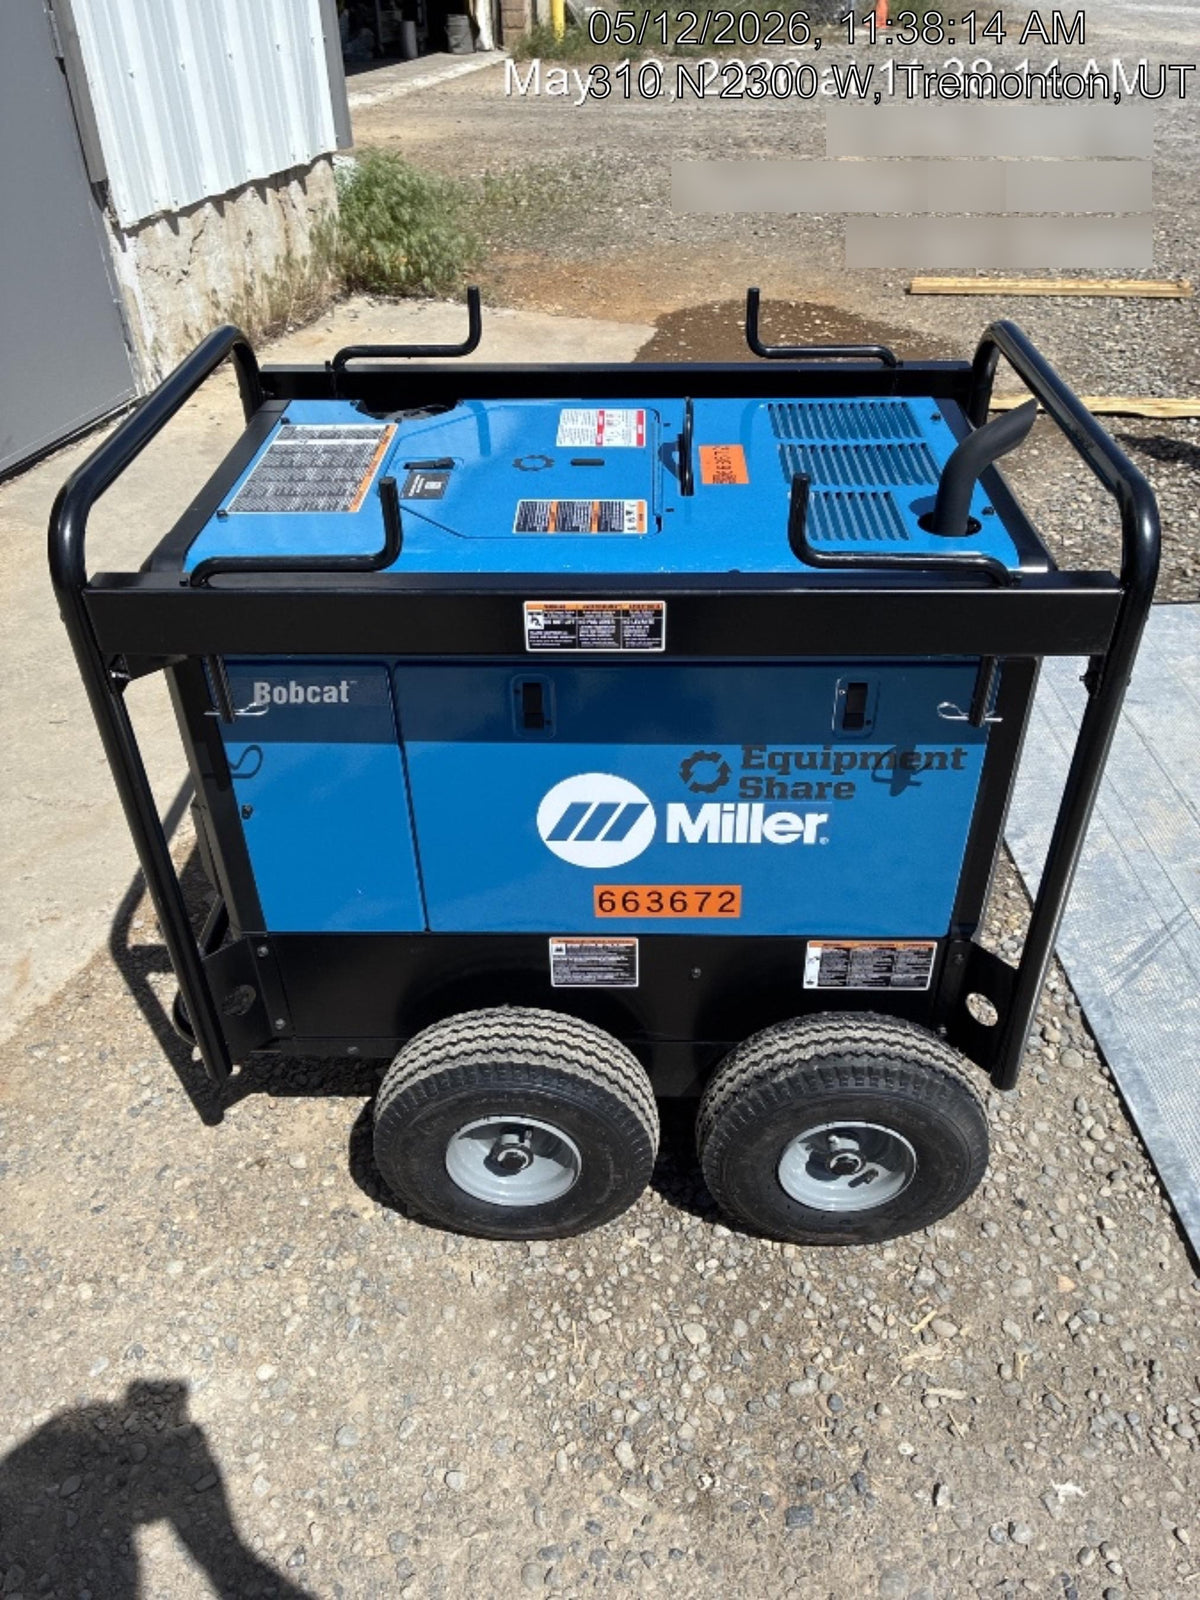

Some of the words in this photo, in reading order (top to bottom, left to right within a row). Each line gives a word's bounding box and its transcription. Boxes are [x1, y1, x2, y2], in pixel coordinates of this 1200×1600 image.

[253, 680, 350, 705] Bobcat
[740, 744, 968, 776] Equipment
[738, 775, 857, 800] Share
[666, 802, 829, 845] Miller
[597, 890, 737, 913] 663672
